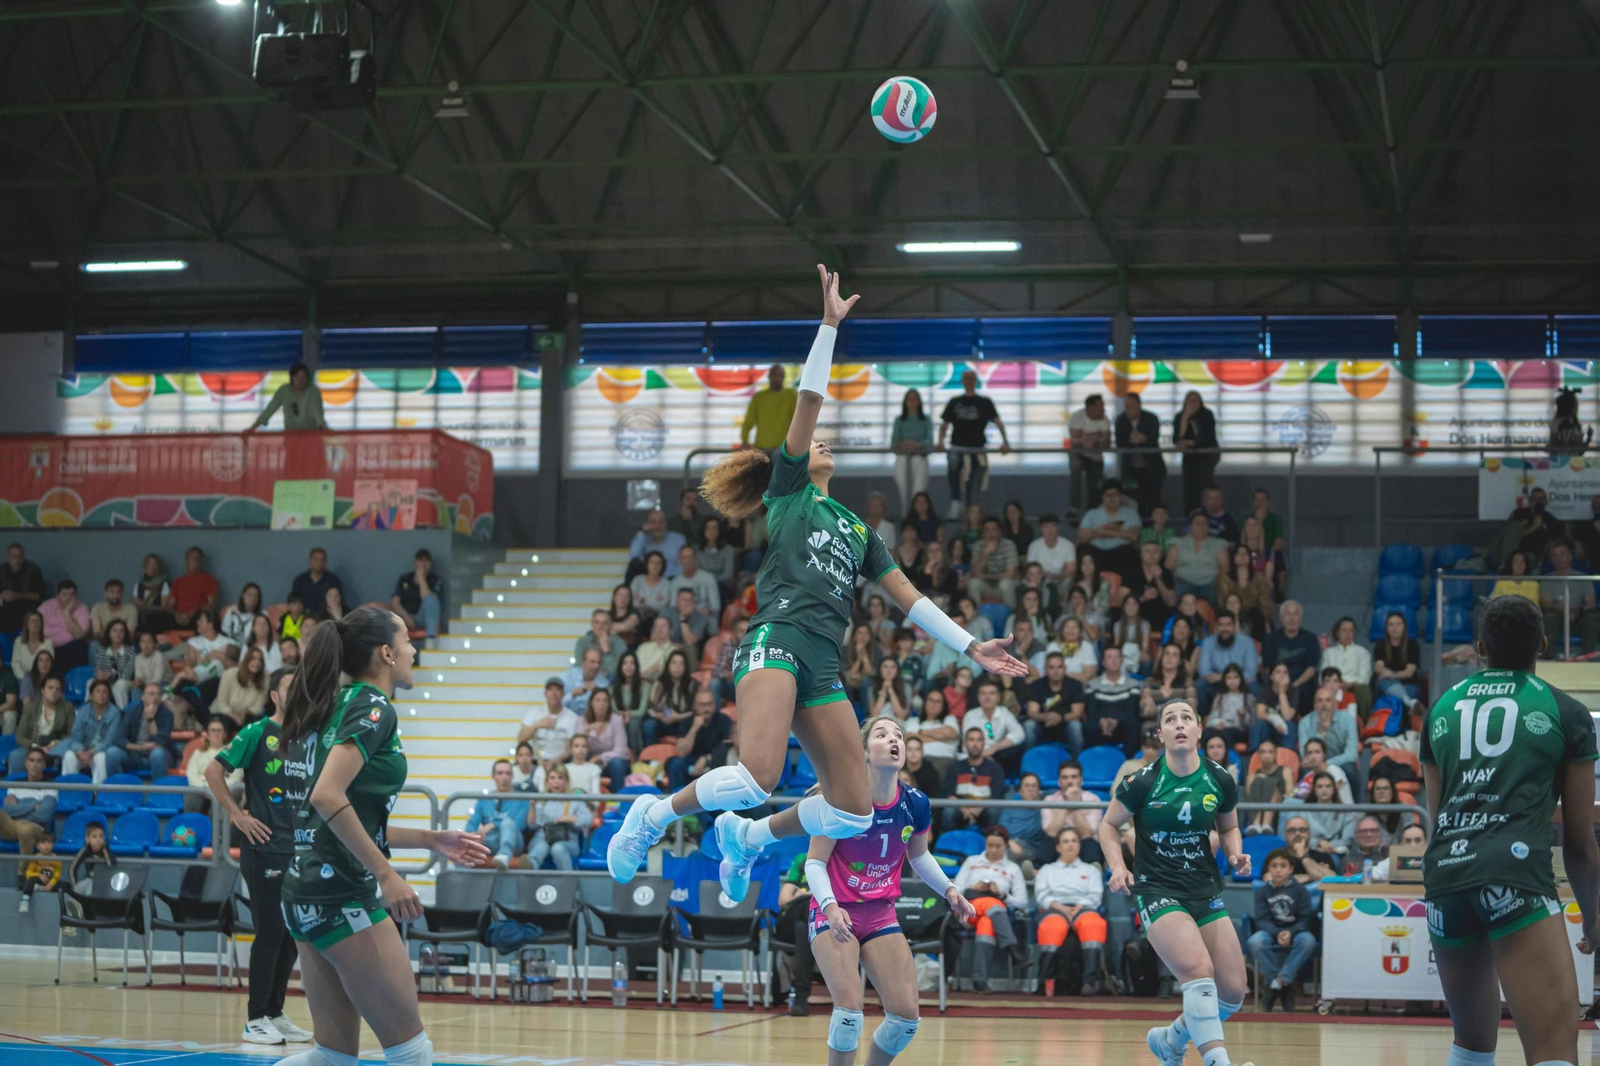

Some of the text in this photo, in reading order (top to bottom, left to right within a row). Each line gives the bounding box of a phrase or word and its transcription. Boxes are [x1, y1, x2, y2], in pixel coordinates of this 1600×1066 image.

[752, 651, 761, 662] 8
[1467, 682, 1516, 697] GREEN
[1454, 697, 1519, 760] 10
[1461, 767, 1497, 784] WAY
[1177, 800, 1192, 825] 4
[880, 833, 889, 858] 1
[1169, 836, 1200, 845] Unicaja
